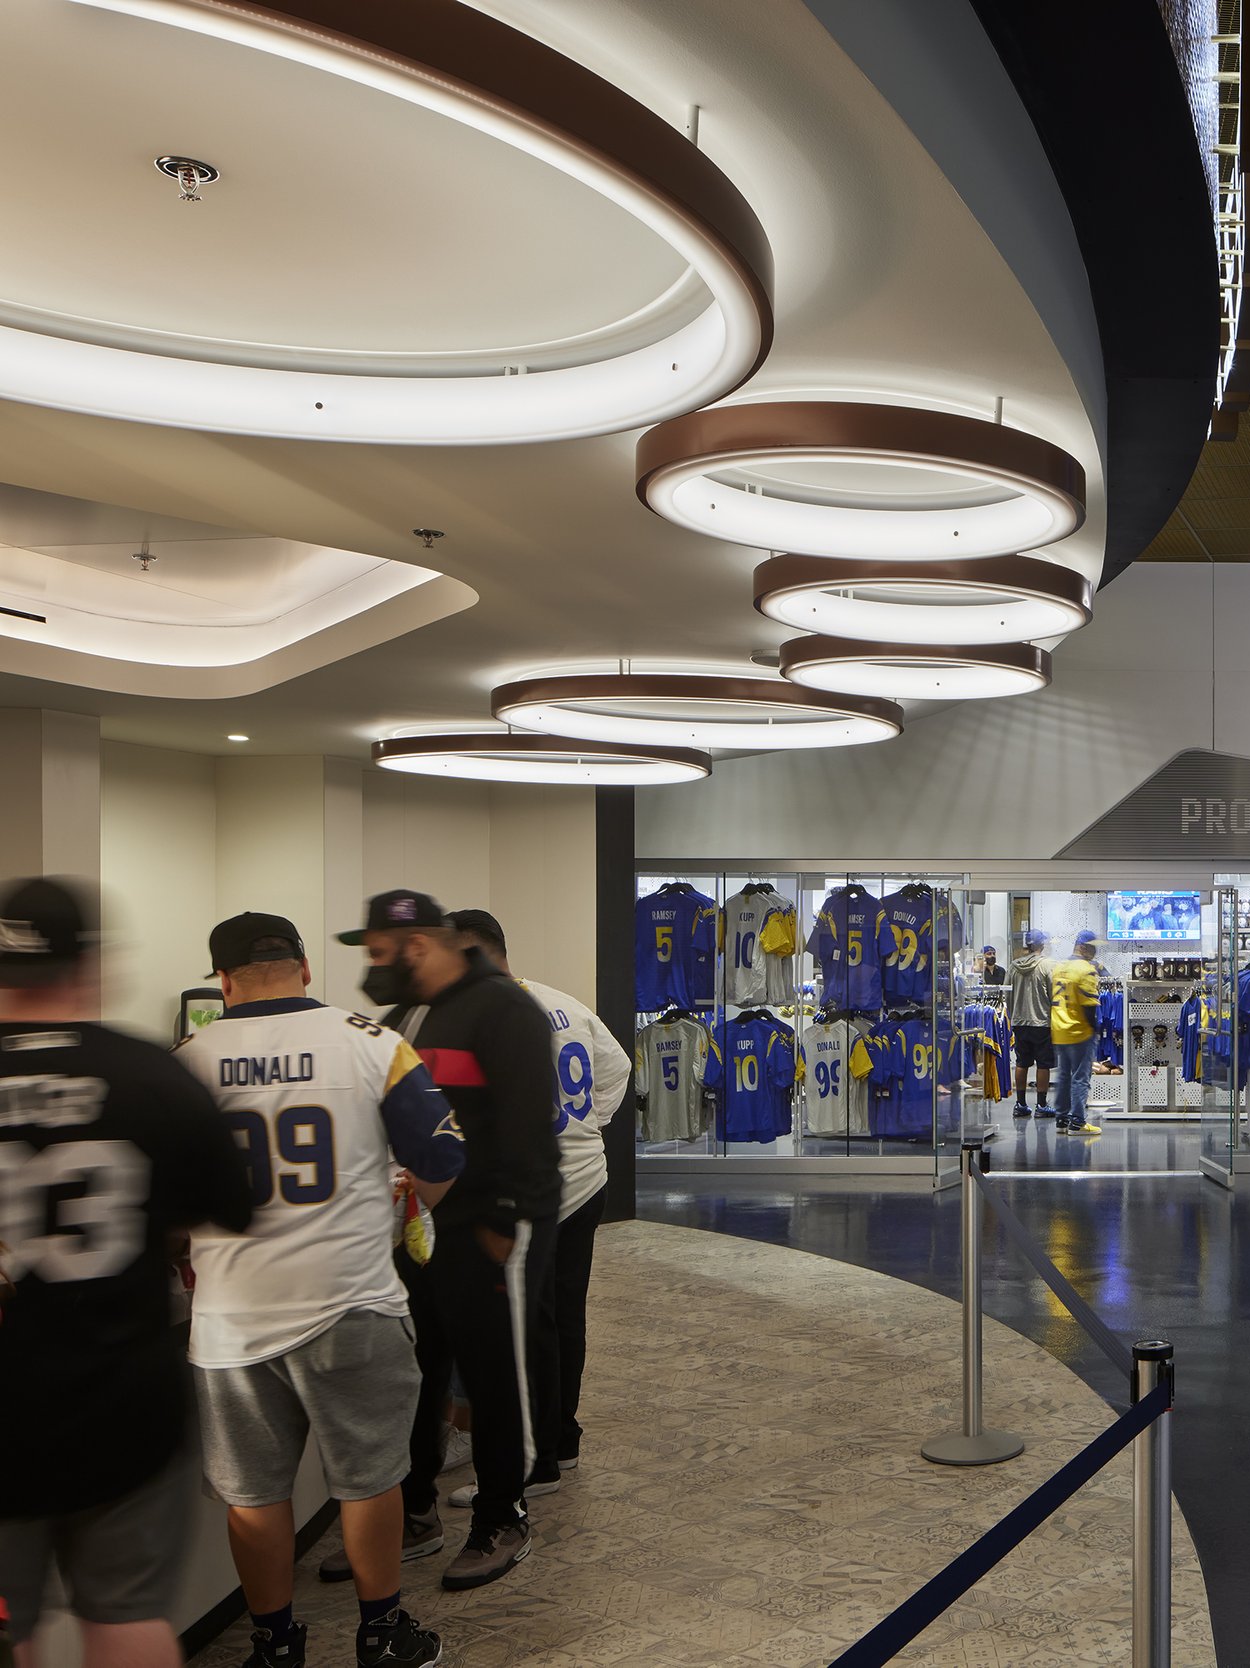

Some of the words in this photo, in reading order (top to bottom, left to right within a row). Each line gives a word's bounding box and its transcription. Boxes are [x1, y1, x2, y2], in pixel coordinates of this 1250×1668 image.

[651, 910, 677, 921] RAMSEY
[655, 926, 673, 963] 5
[735, 931, 756, 969] 10
[848, 930, 863, 967] 5
[656, 1040, 683, 1053] RAMSEY
[737, 1040, 755, 1051] KUPP
[816, 1040, 840, 1053] DONALD
[220, 1052, 313, 1087] DONALD
[661, 1055, 679, 1092] 5
[734, 1055, 759, 1092] 10
